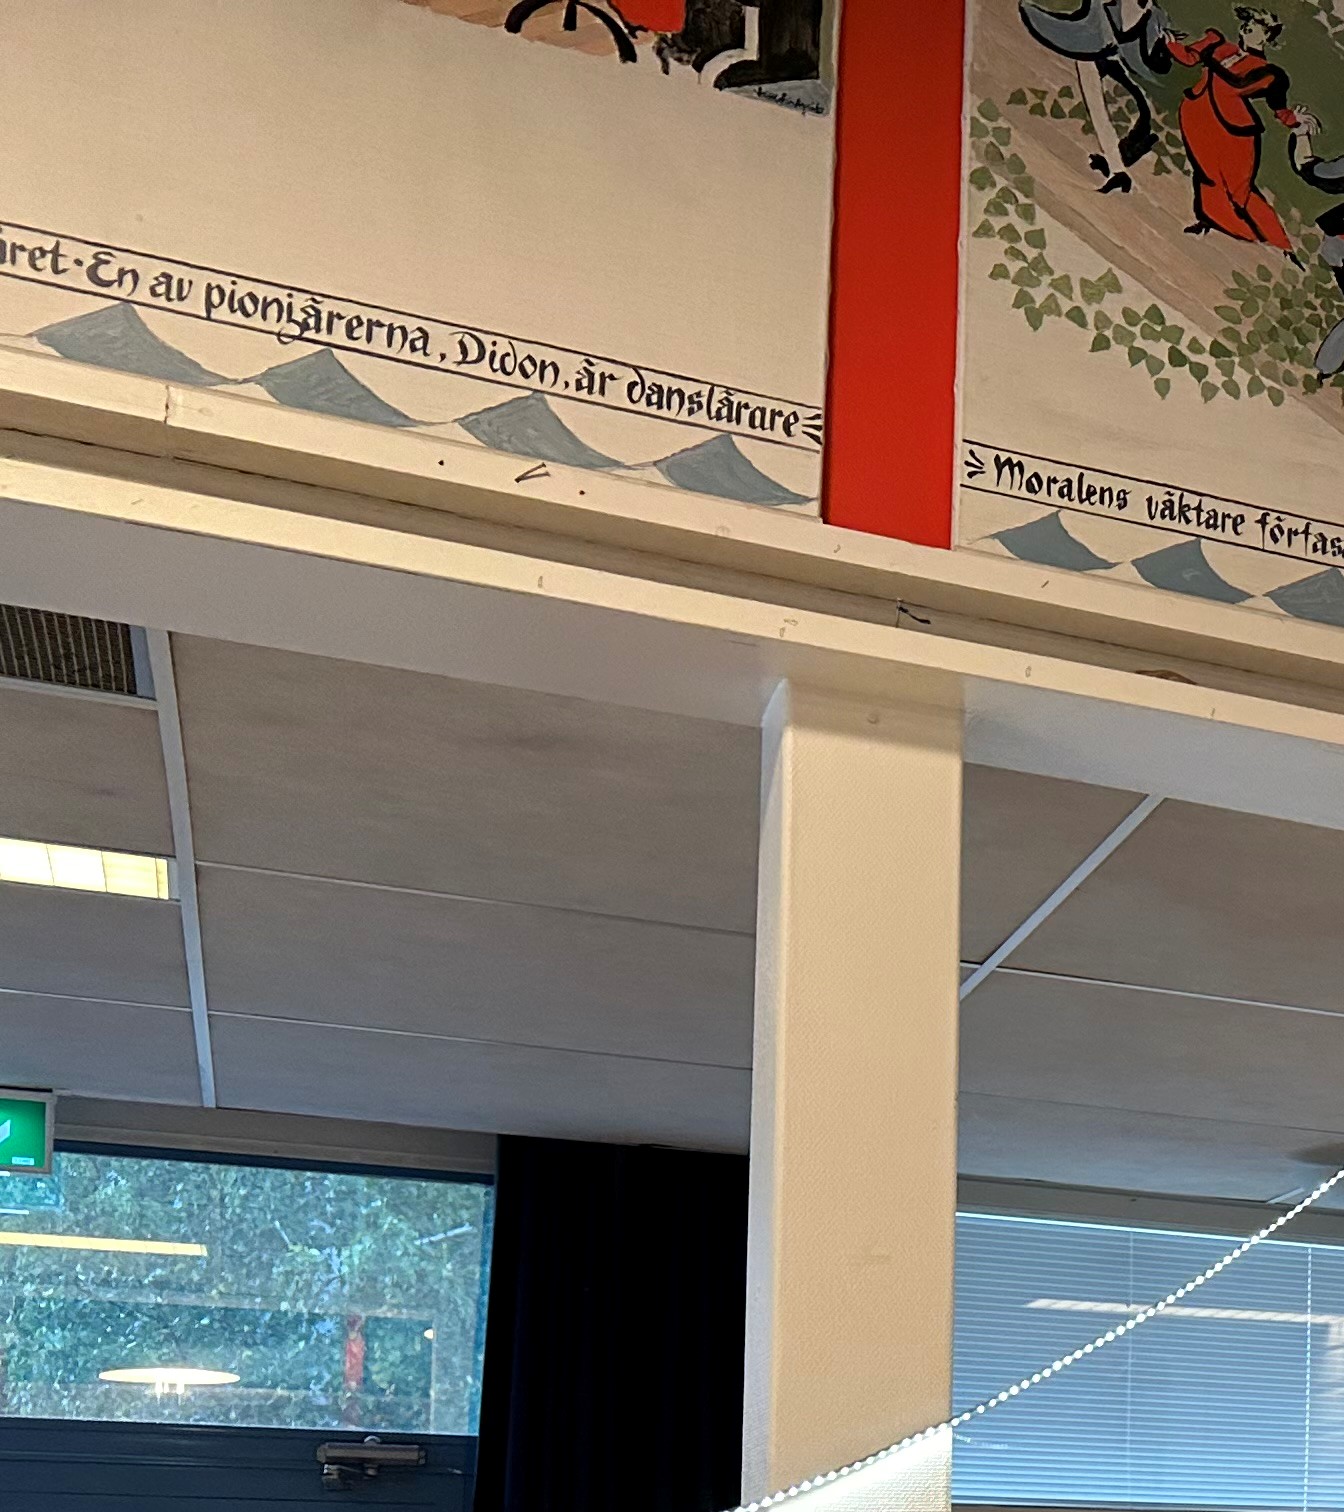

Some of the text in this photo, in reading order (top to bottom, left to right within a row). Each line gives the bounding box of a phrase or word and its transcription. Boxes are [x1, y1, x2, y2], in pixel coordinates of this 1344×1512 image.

[85, 250, 139, 296] En
[149, 271, 193, 302] av
[450, 330, 570, 390] Didon,
[575, 358, 617, 397] är
[626, 366, 801, 437] danslärare
[993, 452, 1131, 510] Moralens
[1146, 491, 1246, 535] väktare
